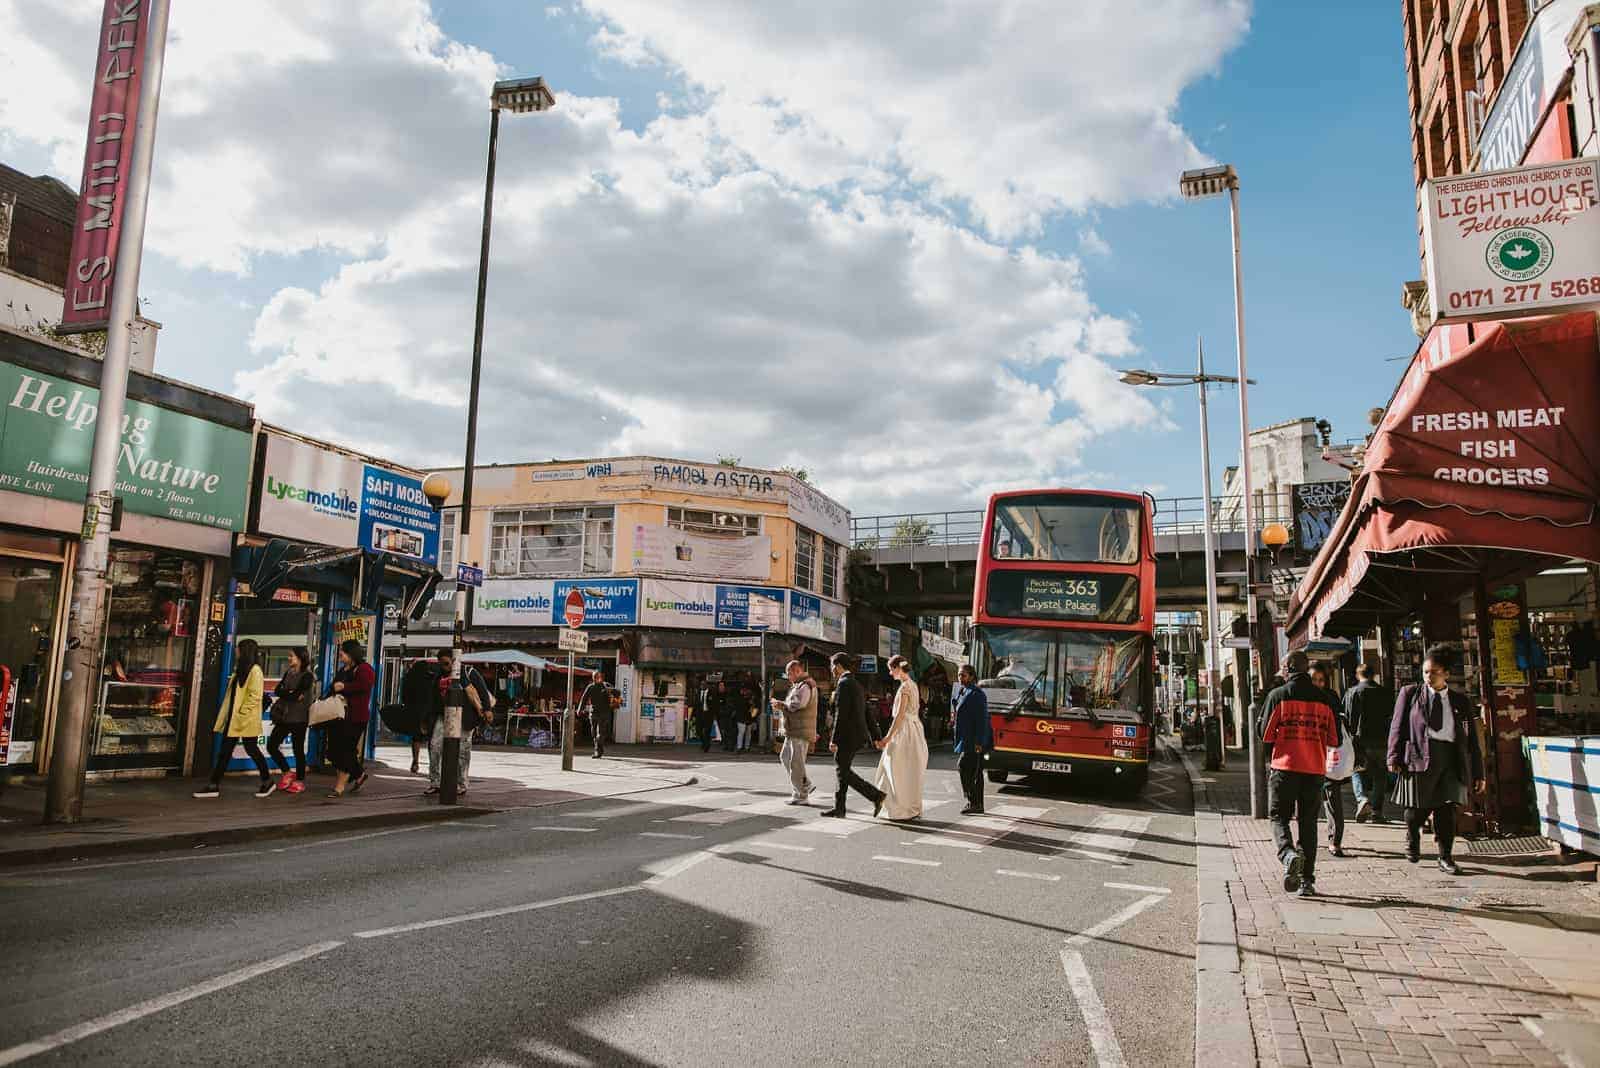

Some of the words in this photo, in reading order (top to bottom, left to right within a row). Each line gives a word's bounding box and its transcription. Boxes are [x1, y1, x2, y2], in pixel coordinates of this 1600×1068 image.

[1436, 185, 1450, 196] THE
[1451, 180, 1489, 193] REDEEMED
[1531, 169, 1561, 182] CHURCH
[1563, 169, 1573, 178] OF
[1575, 166, 1592, 177] GOD
[1437, 180, 1595, 219] LIGHTHOUSE
[1449, 288, 1494, 310] 0171
[1503, 283, 1542, 304] 277
[1550, 276, 1600, 299] 5268
[1412, 411, 1489, 432] FRESH
[1496, 407, 1565, 428] MEAT
[1460, 440, 1516, 459] FISH
[117, 442, 221, 494] Nature
[1434, 467, 1550, 486] GROCERS
[25, 480, 55, 493] LANE
[141, 487, 153, 497] on
[157, 488, 164, 498] 2
[267, 476, 358, 514] Lycamobile
[367, 476, 394, 497] SAFI
[1065, 580, 1098, 595] 363
[478, 592, 550, 610] Lycamobile
[585, 599, 612, 610] ALON
[646, 597, 714, 615] Lycamobile
[1025, 598, 1061, 610] Crystal
[1065, 599, 1097, 611] Palace
[1036, 720, 1054, 734] Go
